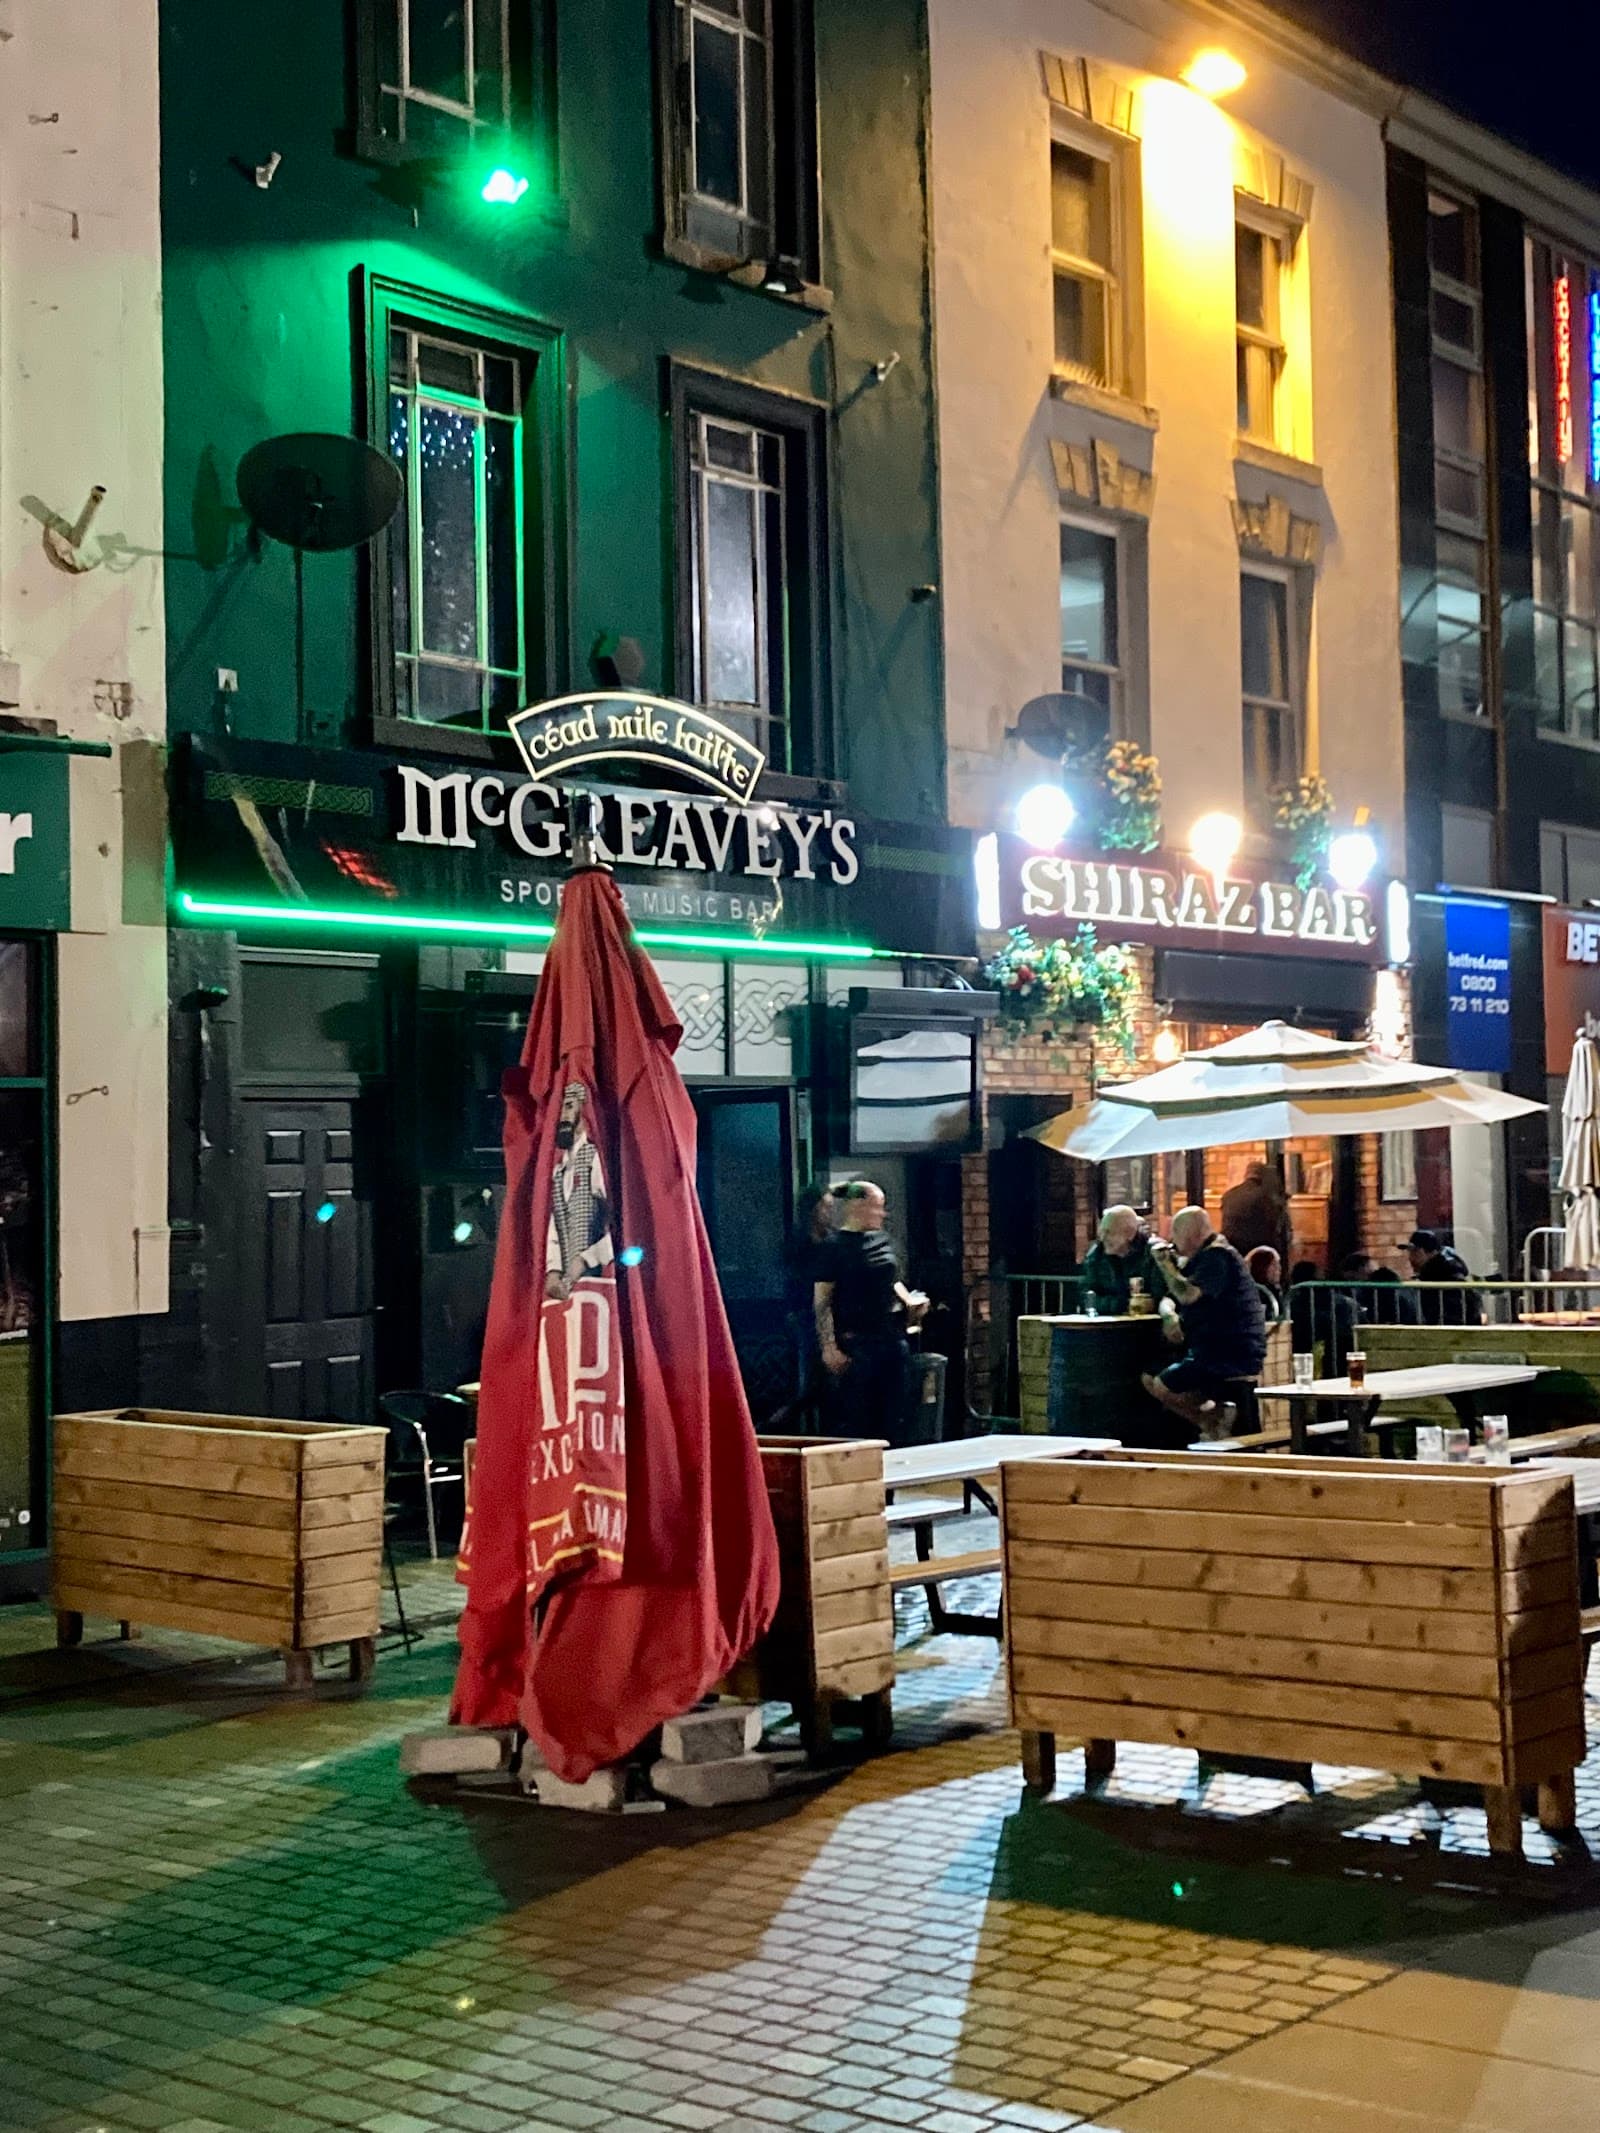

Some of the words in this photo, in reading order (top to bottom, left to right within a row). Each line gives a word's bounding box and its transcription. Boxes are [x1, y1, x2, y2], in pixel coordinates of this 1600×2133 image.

[530, 705, 599, 759] céad
[643, 892, 717, 918] MUSIC
[730, 898, 774, 921] BAR
[1021, 856, 1256, 934] SHIRAZ
[1260, 881, 1376, 945] BAR
[1566, 922, 1600, 962] BE
[1448, 951, 1508, 970] betfred.com
[1461, 975, 1496, 991] 0800
[1450, 996, 1467, 1012] 73
[1470, 998, 1482, 1013] 11
[1485, 998, 1509, 1014] 210
